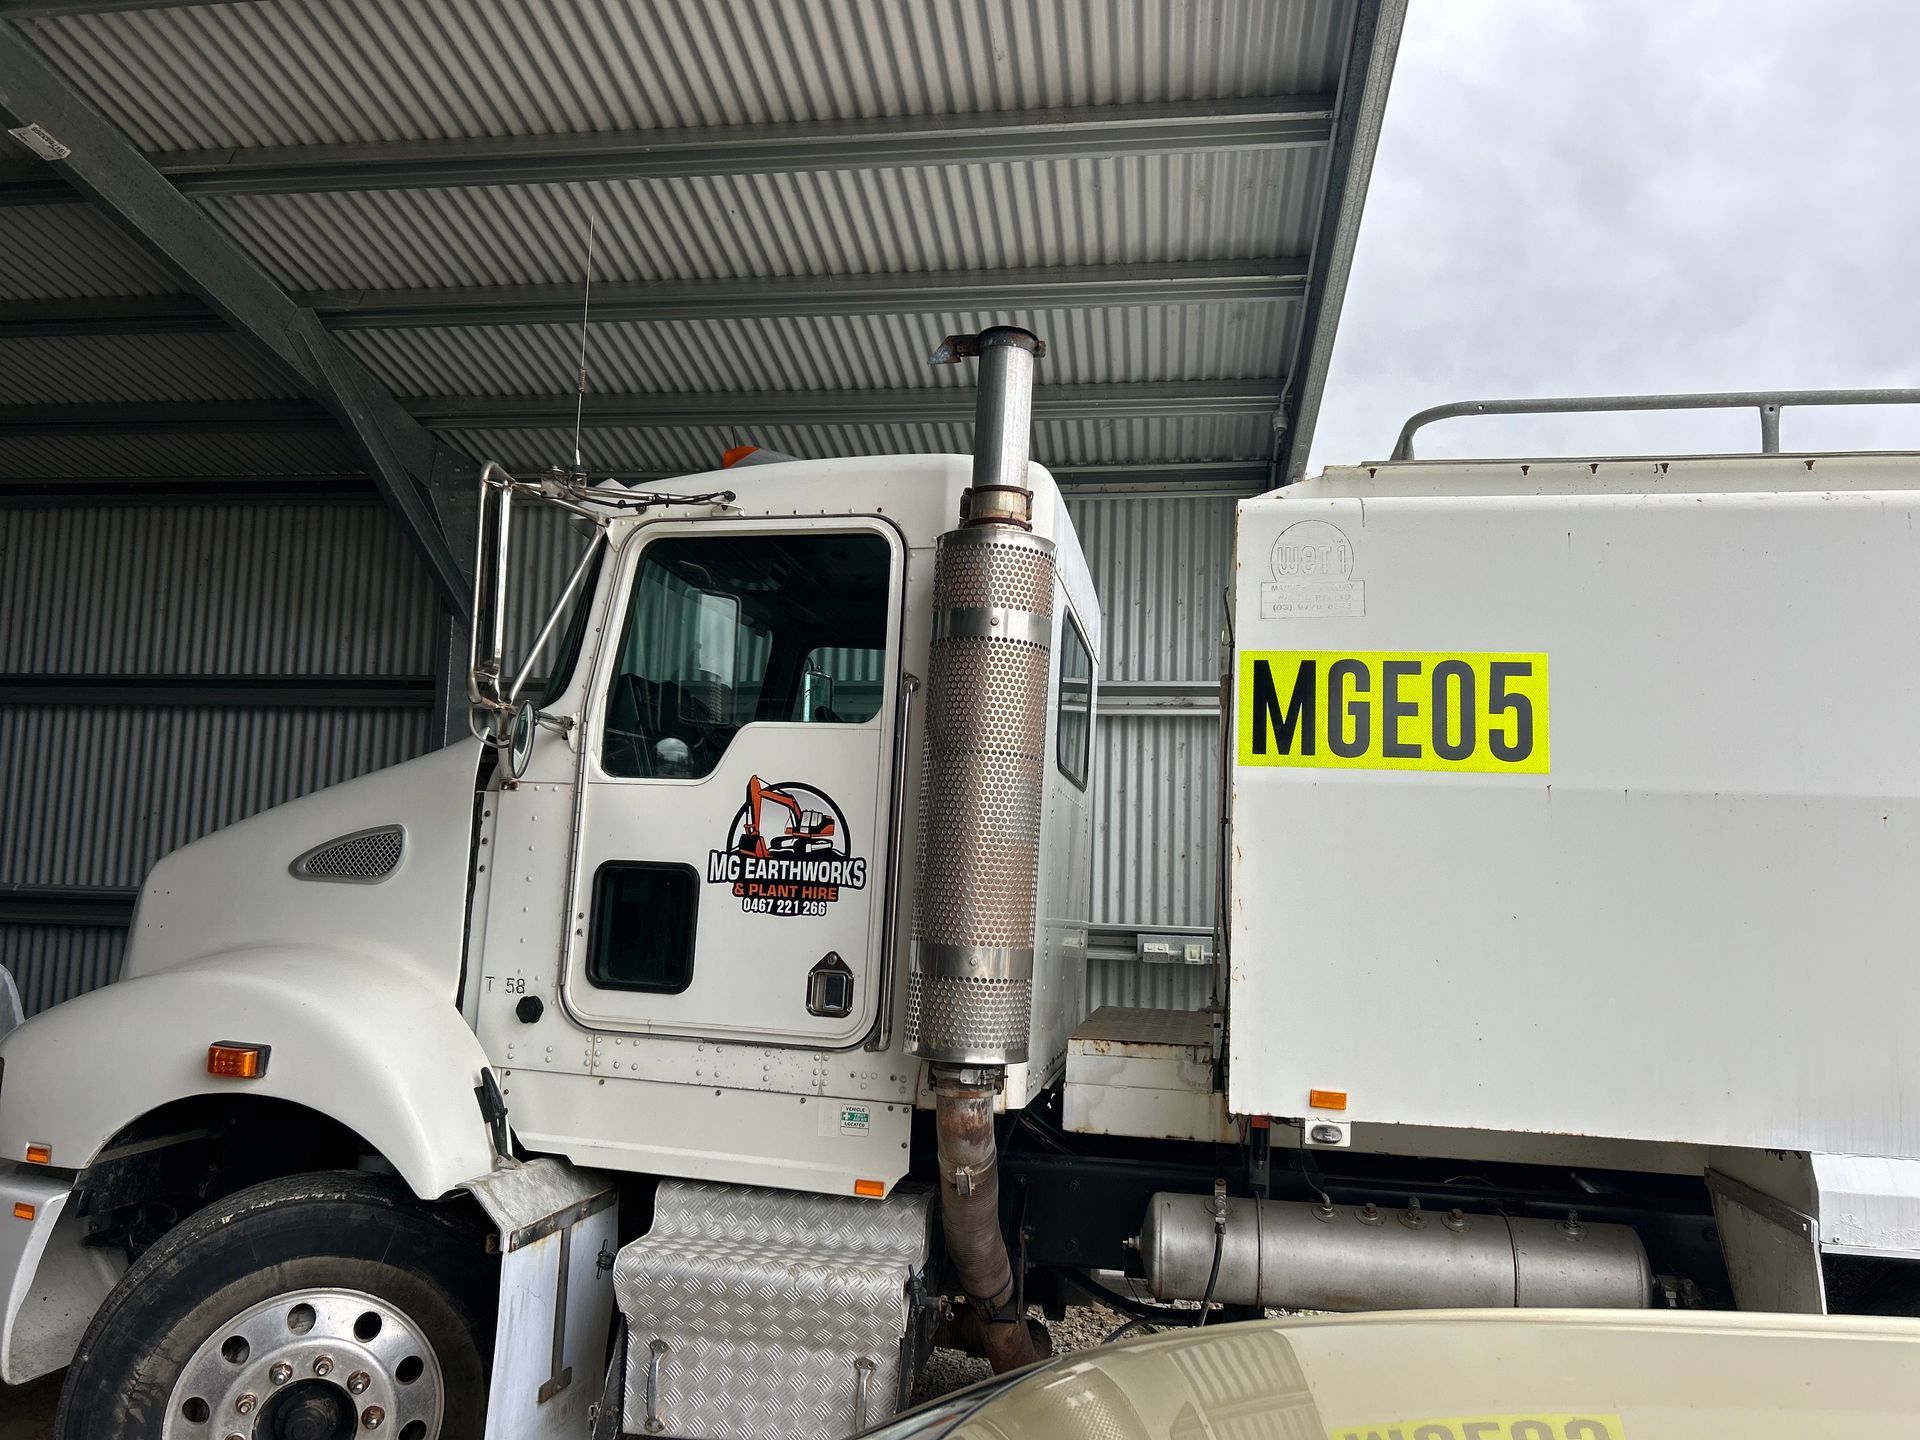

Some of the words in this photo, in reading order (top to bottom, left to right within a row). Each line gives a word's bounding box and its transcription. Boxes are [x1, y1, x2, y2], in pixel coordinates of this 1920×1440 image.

[1252, 658, 1533, 763] MGE05
[709, 851, 741, 881] MG
[745, 858, 866, 888] EARTHWORKS
[734, 882, 745, 896] &
[749, 883, 798, 898] PLANT
[802, 885, 838, 900] HIRE
[743, 898, 774, 913] 0467
[777, 899, 799, 914] 221
[803, 901, 826, 916] 266
[485, 976, 495, 992] T
[505, 977, 525, 994] 58
